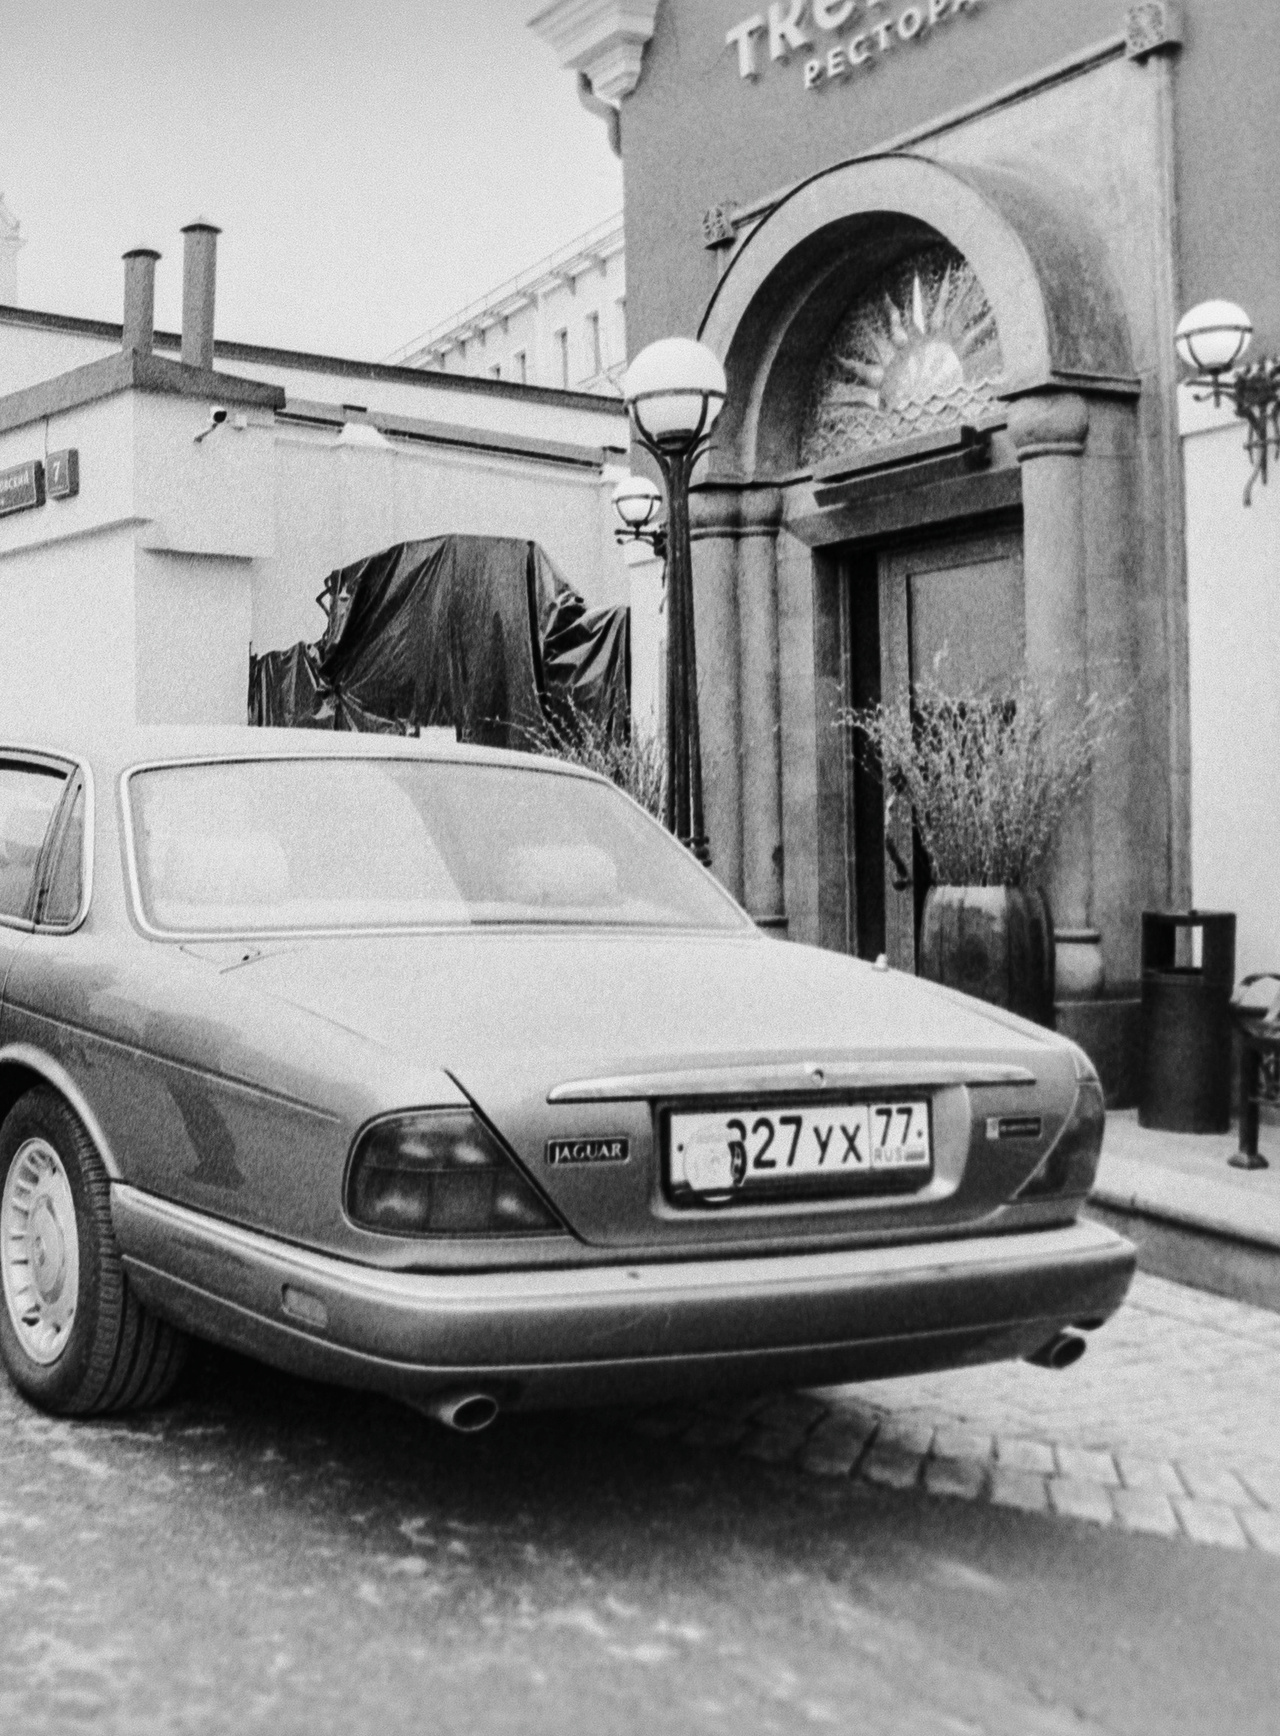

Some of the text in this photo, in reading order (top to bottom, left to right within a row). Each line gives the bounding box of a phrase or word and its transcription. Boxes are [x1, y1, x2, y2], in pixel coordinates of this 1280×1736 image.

[725, 0, 870, 78] ТКЕ
[875, 1107, 913, 1147] 77
[554, 1142, 623, 1165] JAGUAR
